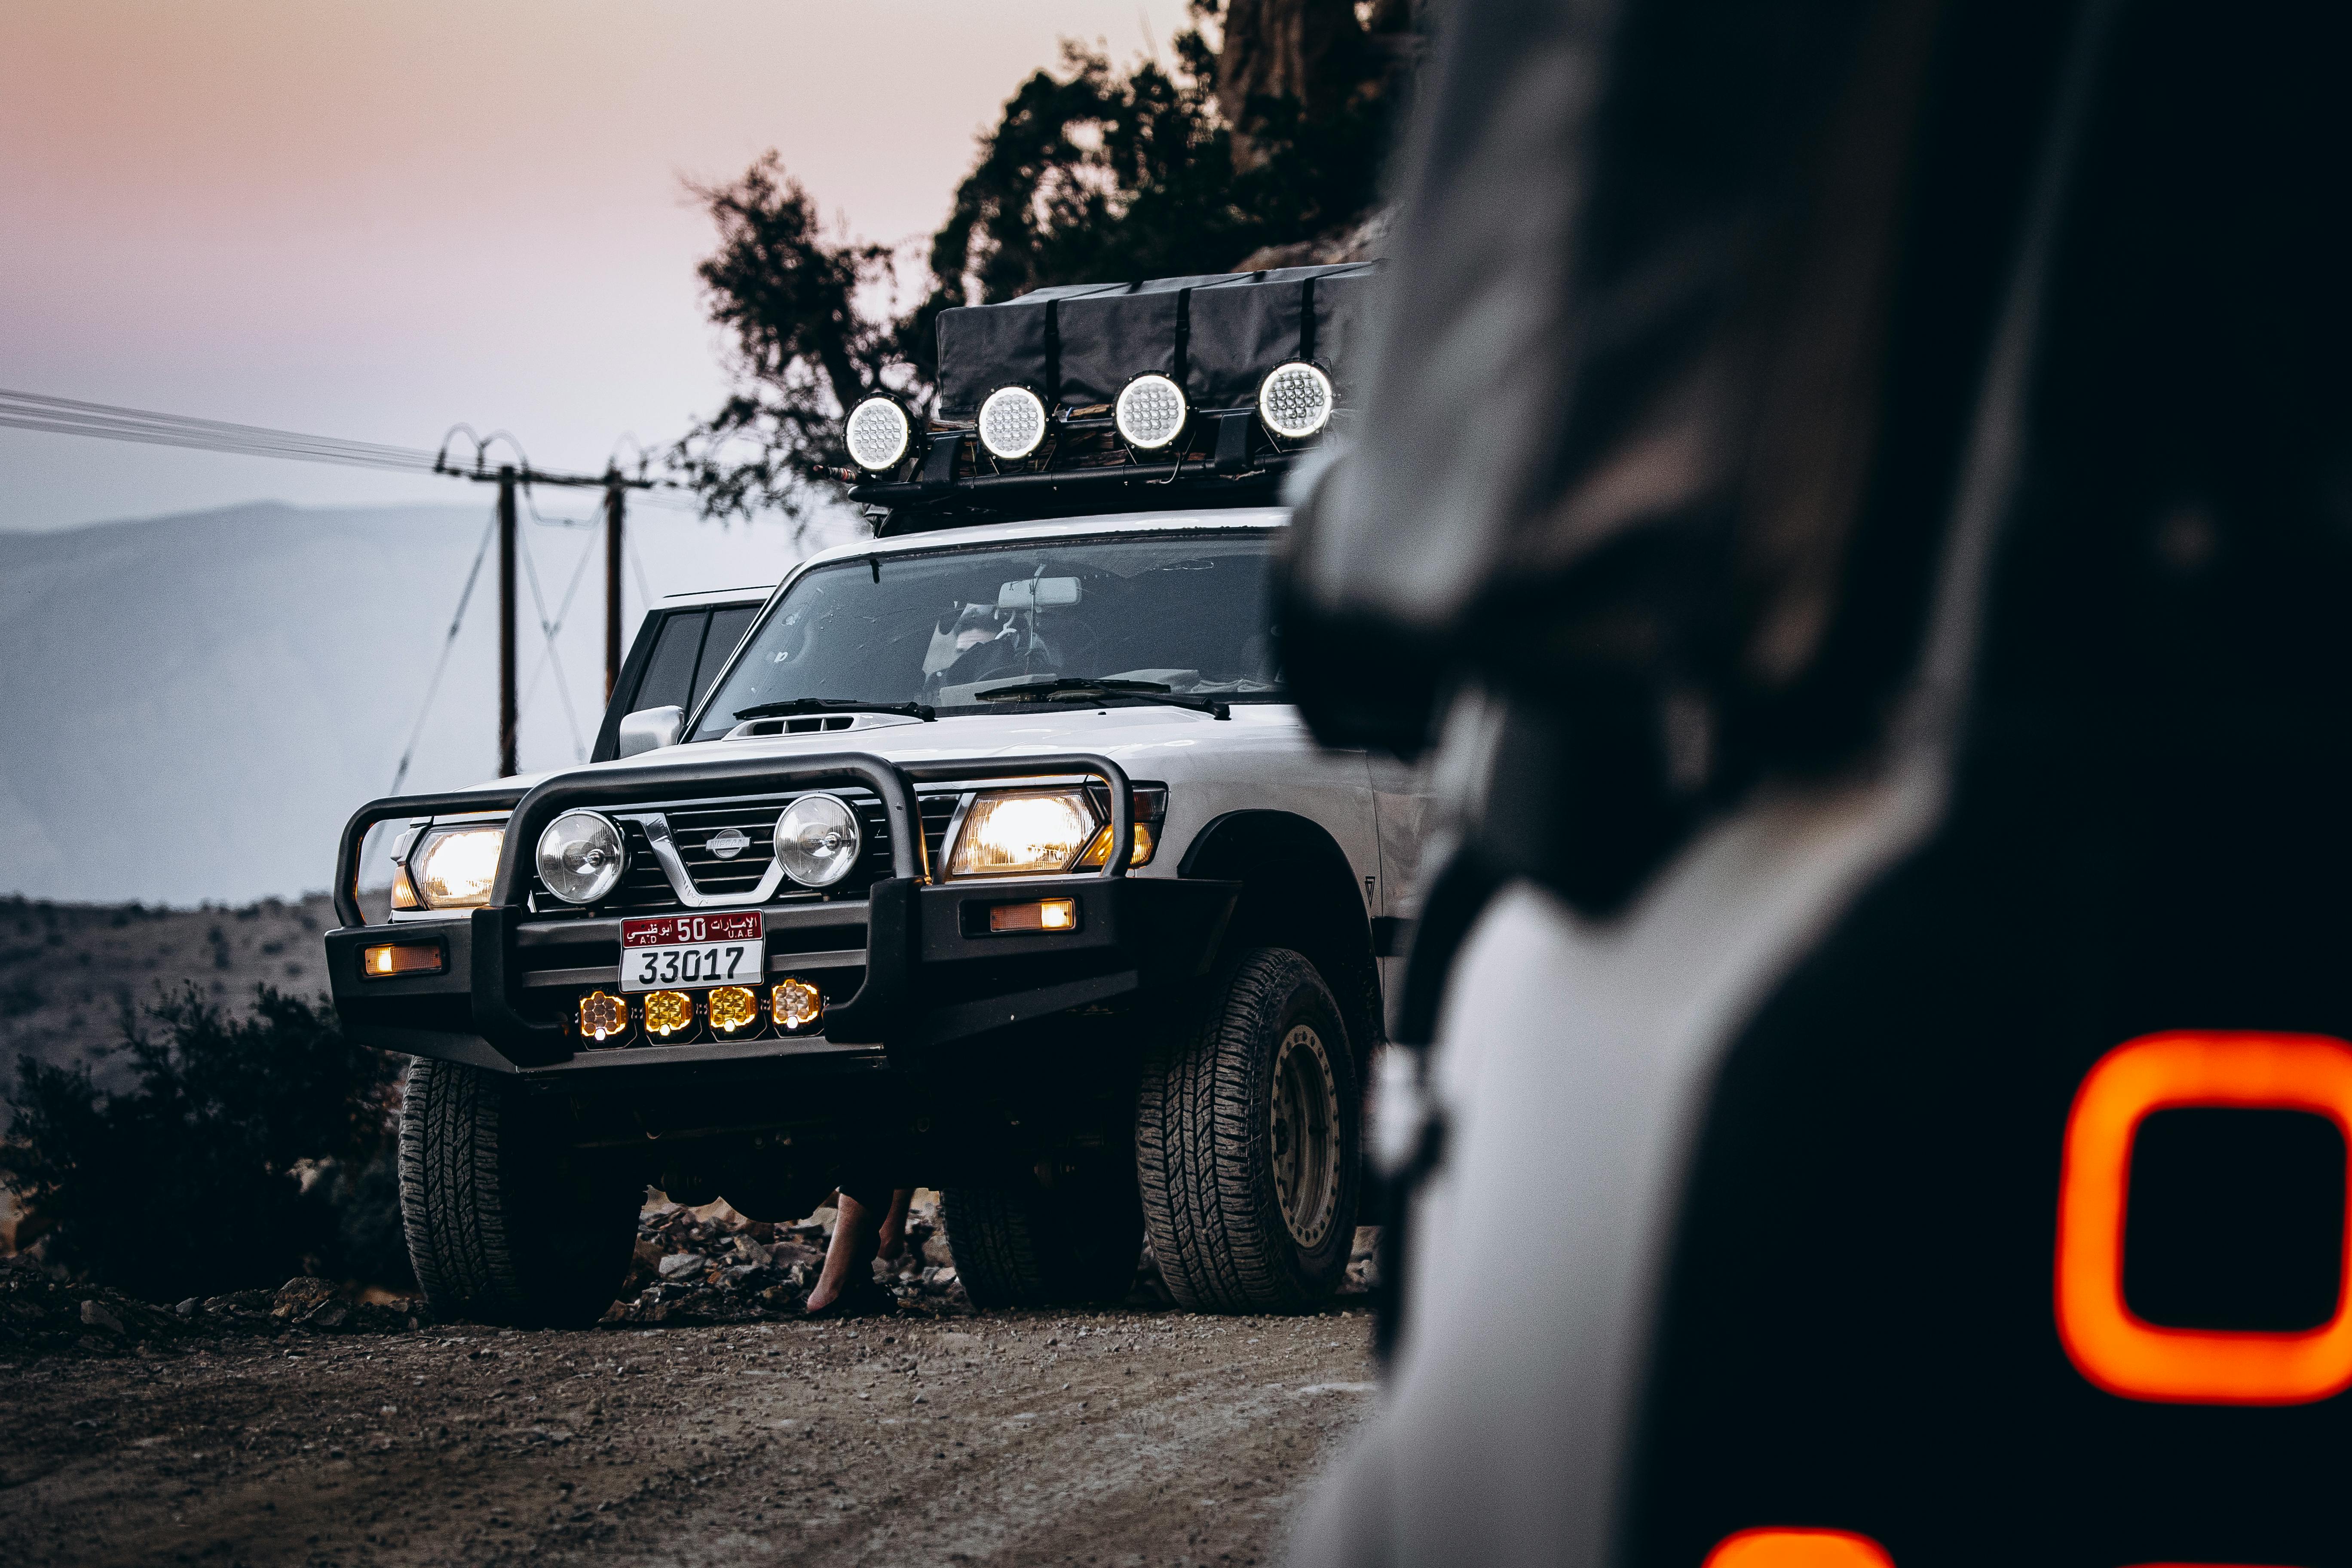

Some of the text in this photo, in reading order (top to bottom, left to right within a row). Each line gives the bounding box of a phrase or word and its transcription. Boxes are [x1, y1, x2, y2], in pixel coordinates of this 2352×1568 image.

[710, 838, 746, 848] NISSAN
[677, 918, 706, 941] 50
[728, 929, 753, 938] U.A.E
[640, 936, 657, 944] A.D
[639, 946, 744, 984] 33017
